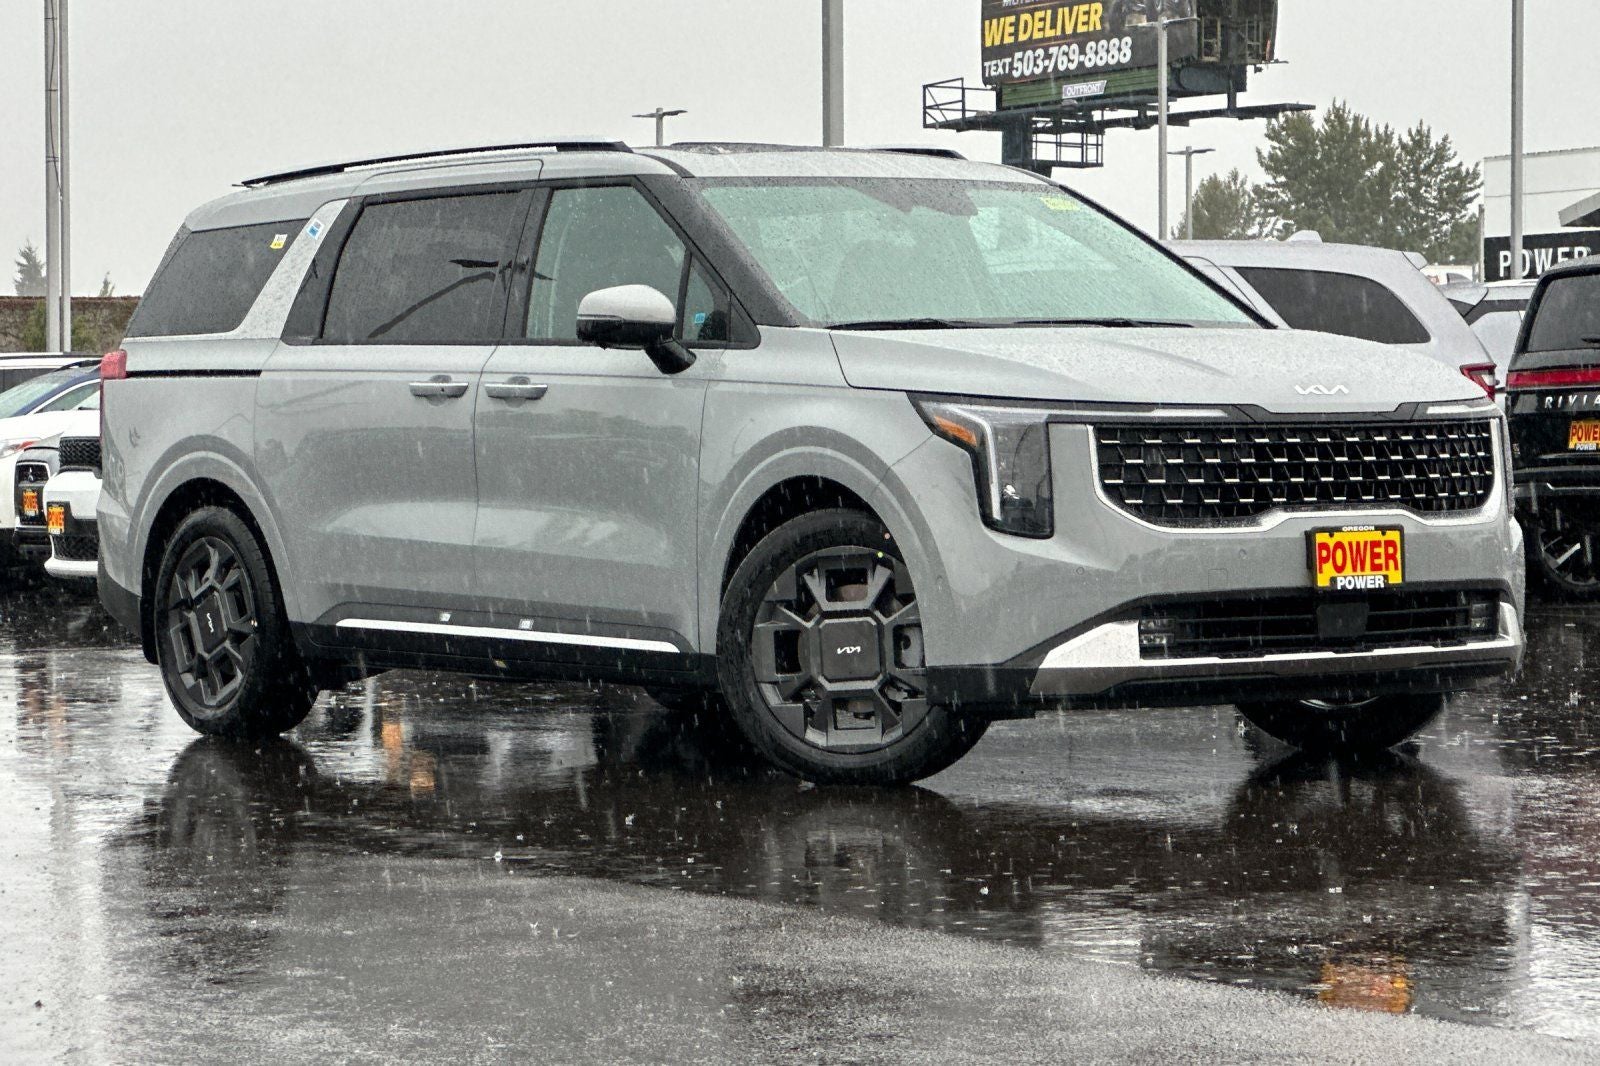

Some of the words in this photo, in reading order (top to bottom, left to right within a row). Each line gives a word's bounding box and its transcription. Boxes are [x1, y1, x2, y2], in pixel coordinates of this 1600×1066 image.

[984, 15, 1016, 48] WE
[1018, 2, 1103, 41] DELIVER
[983, 57, 1012, 77] TEXT
[1012, 36, 1132, 78] 503-769-8888
[1066, 83, 1102, 97] OUTFRONT
[1571, 424, 1600, 442] POWE
[1576, 443, 1597, 451] POWER
[1317, 539, 1399, 574] POWER
[1336, 575, 1385, 590] POWER
